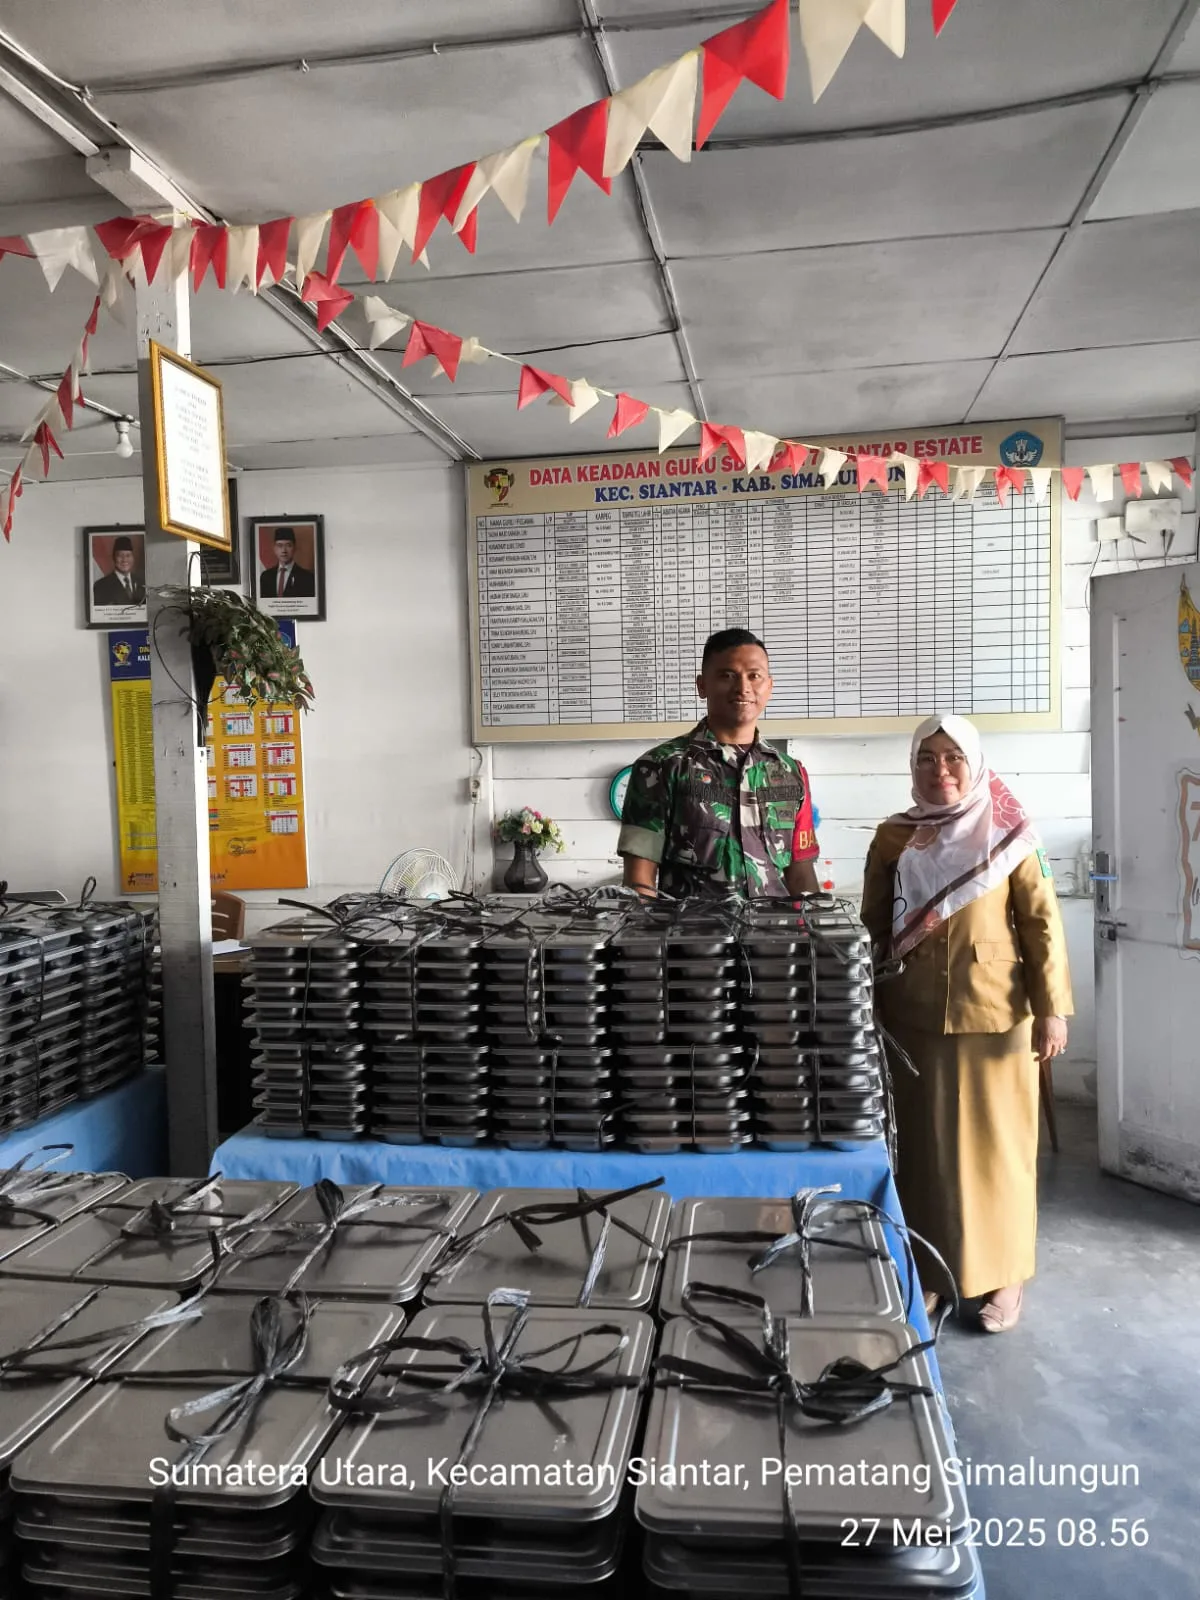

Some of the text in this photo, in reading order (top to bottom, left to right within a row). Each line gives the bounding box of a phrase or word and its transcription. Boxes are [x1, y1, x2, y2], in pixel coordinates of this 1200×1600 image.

[530, 467, 572, 485] DATA
[577, 460, 660, 482] KEADAAN
[665, 456, 716, 476] GURU
[914, 436, 983, 458] ESTATE
[594, 487, 634, 502] KEC.
[639, 480, 718, 499] SIANTAR
[732, 476, 775, 493] KAB.
